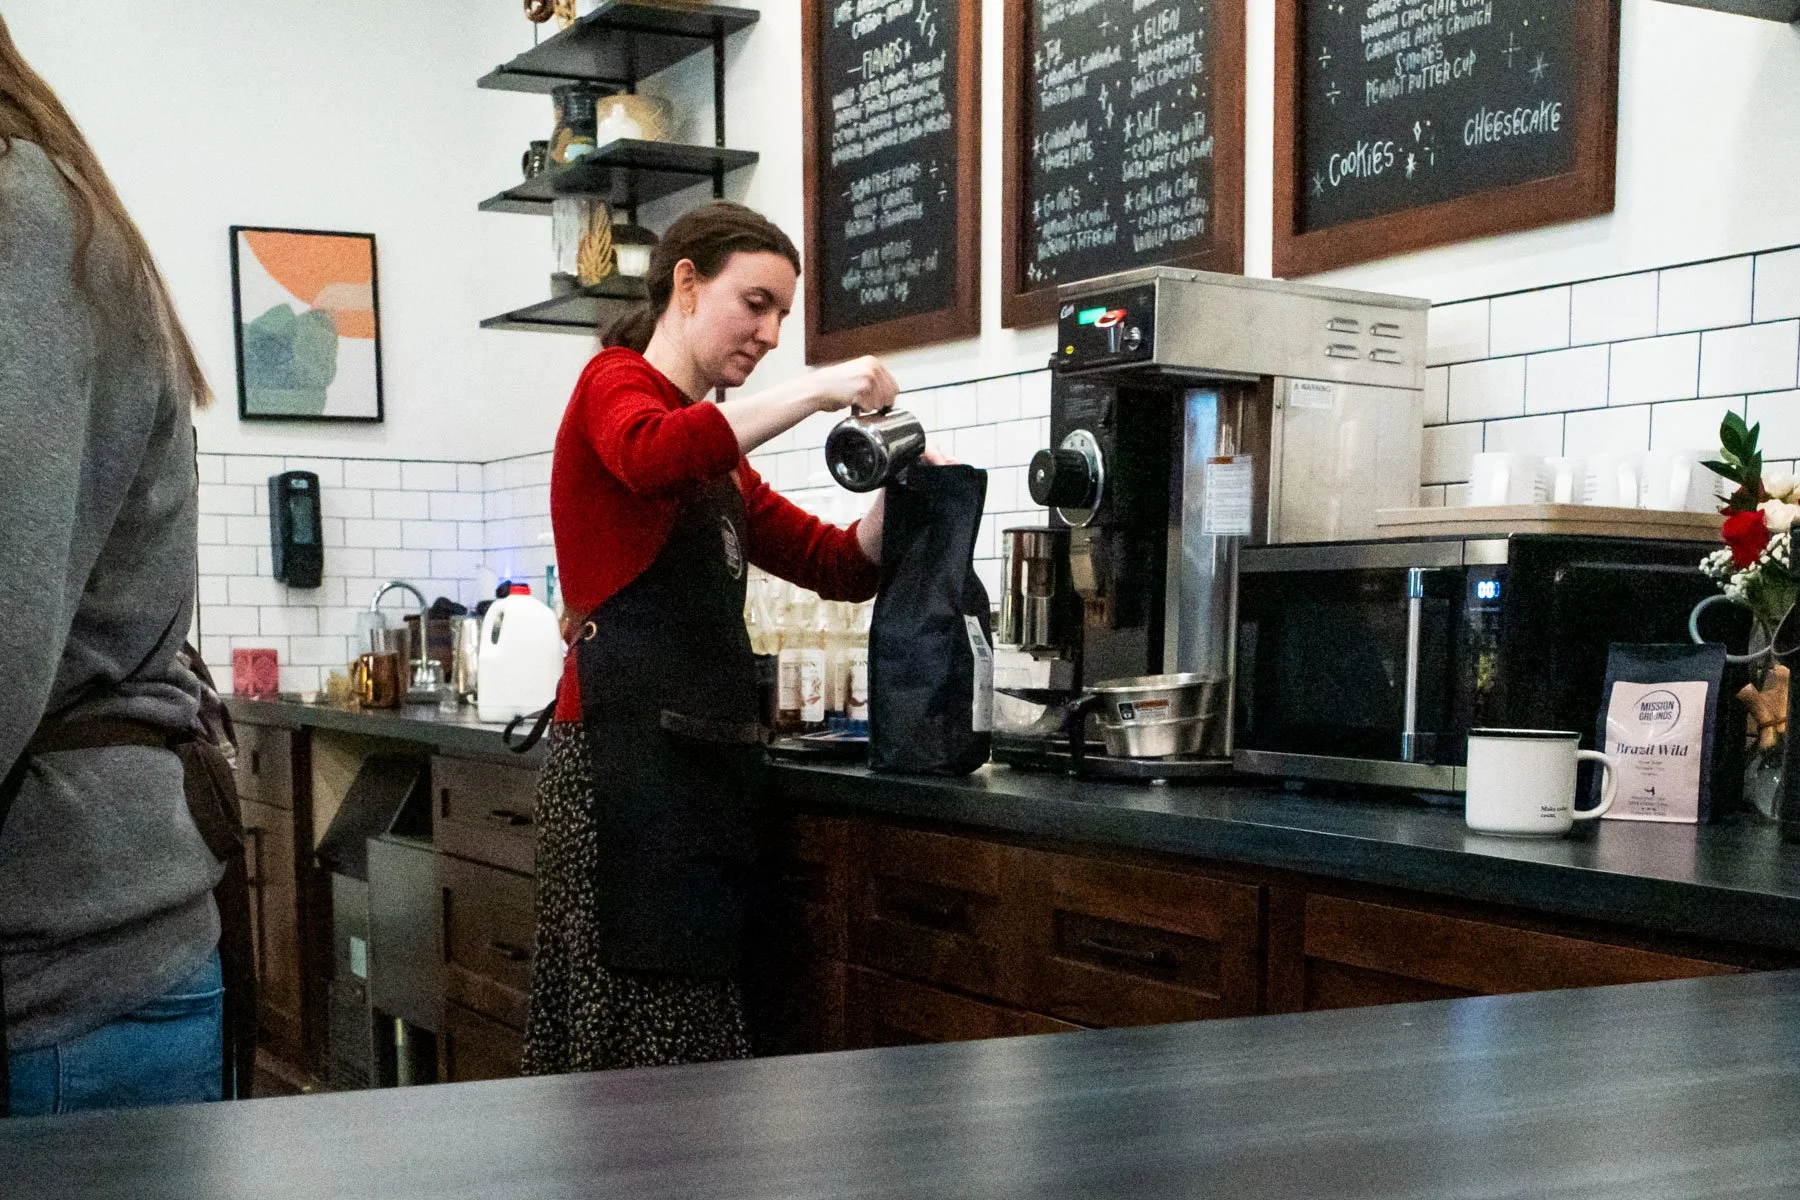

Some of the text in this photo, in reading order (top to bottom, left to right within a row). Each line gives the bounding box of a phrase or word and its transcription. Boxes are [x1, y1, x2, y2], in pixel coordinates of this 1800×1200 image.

[1365, 1, 1492, 61] CARAMEL APPLE CRUNCH
[1401, 0, 1457, 28] CHOCOLATE
[1366, 49, 1477, 107] PEANUT BUTTER CUP
[1463, 100, 1562, 146] CHEESECAKE
[1328, 140, 1395, 187] COOKIES
[1638, 711, 1673, 721] GROUNDS
[1640, 700, 1675, 712] MISSION
[1616, 742, 1689, 757] Brazil Wild
